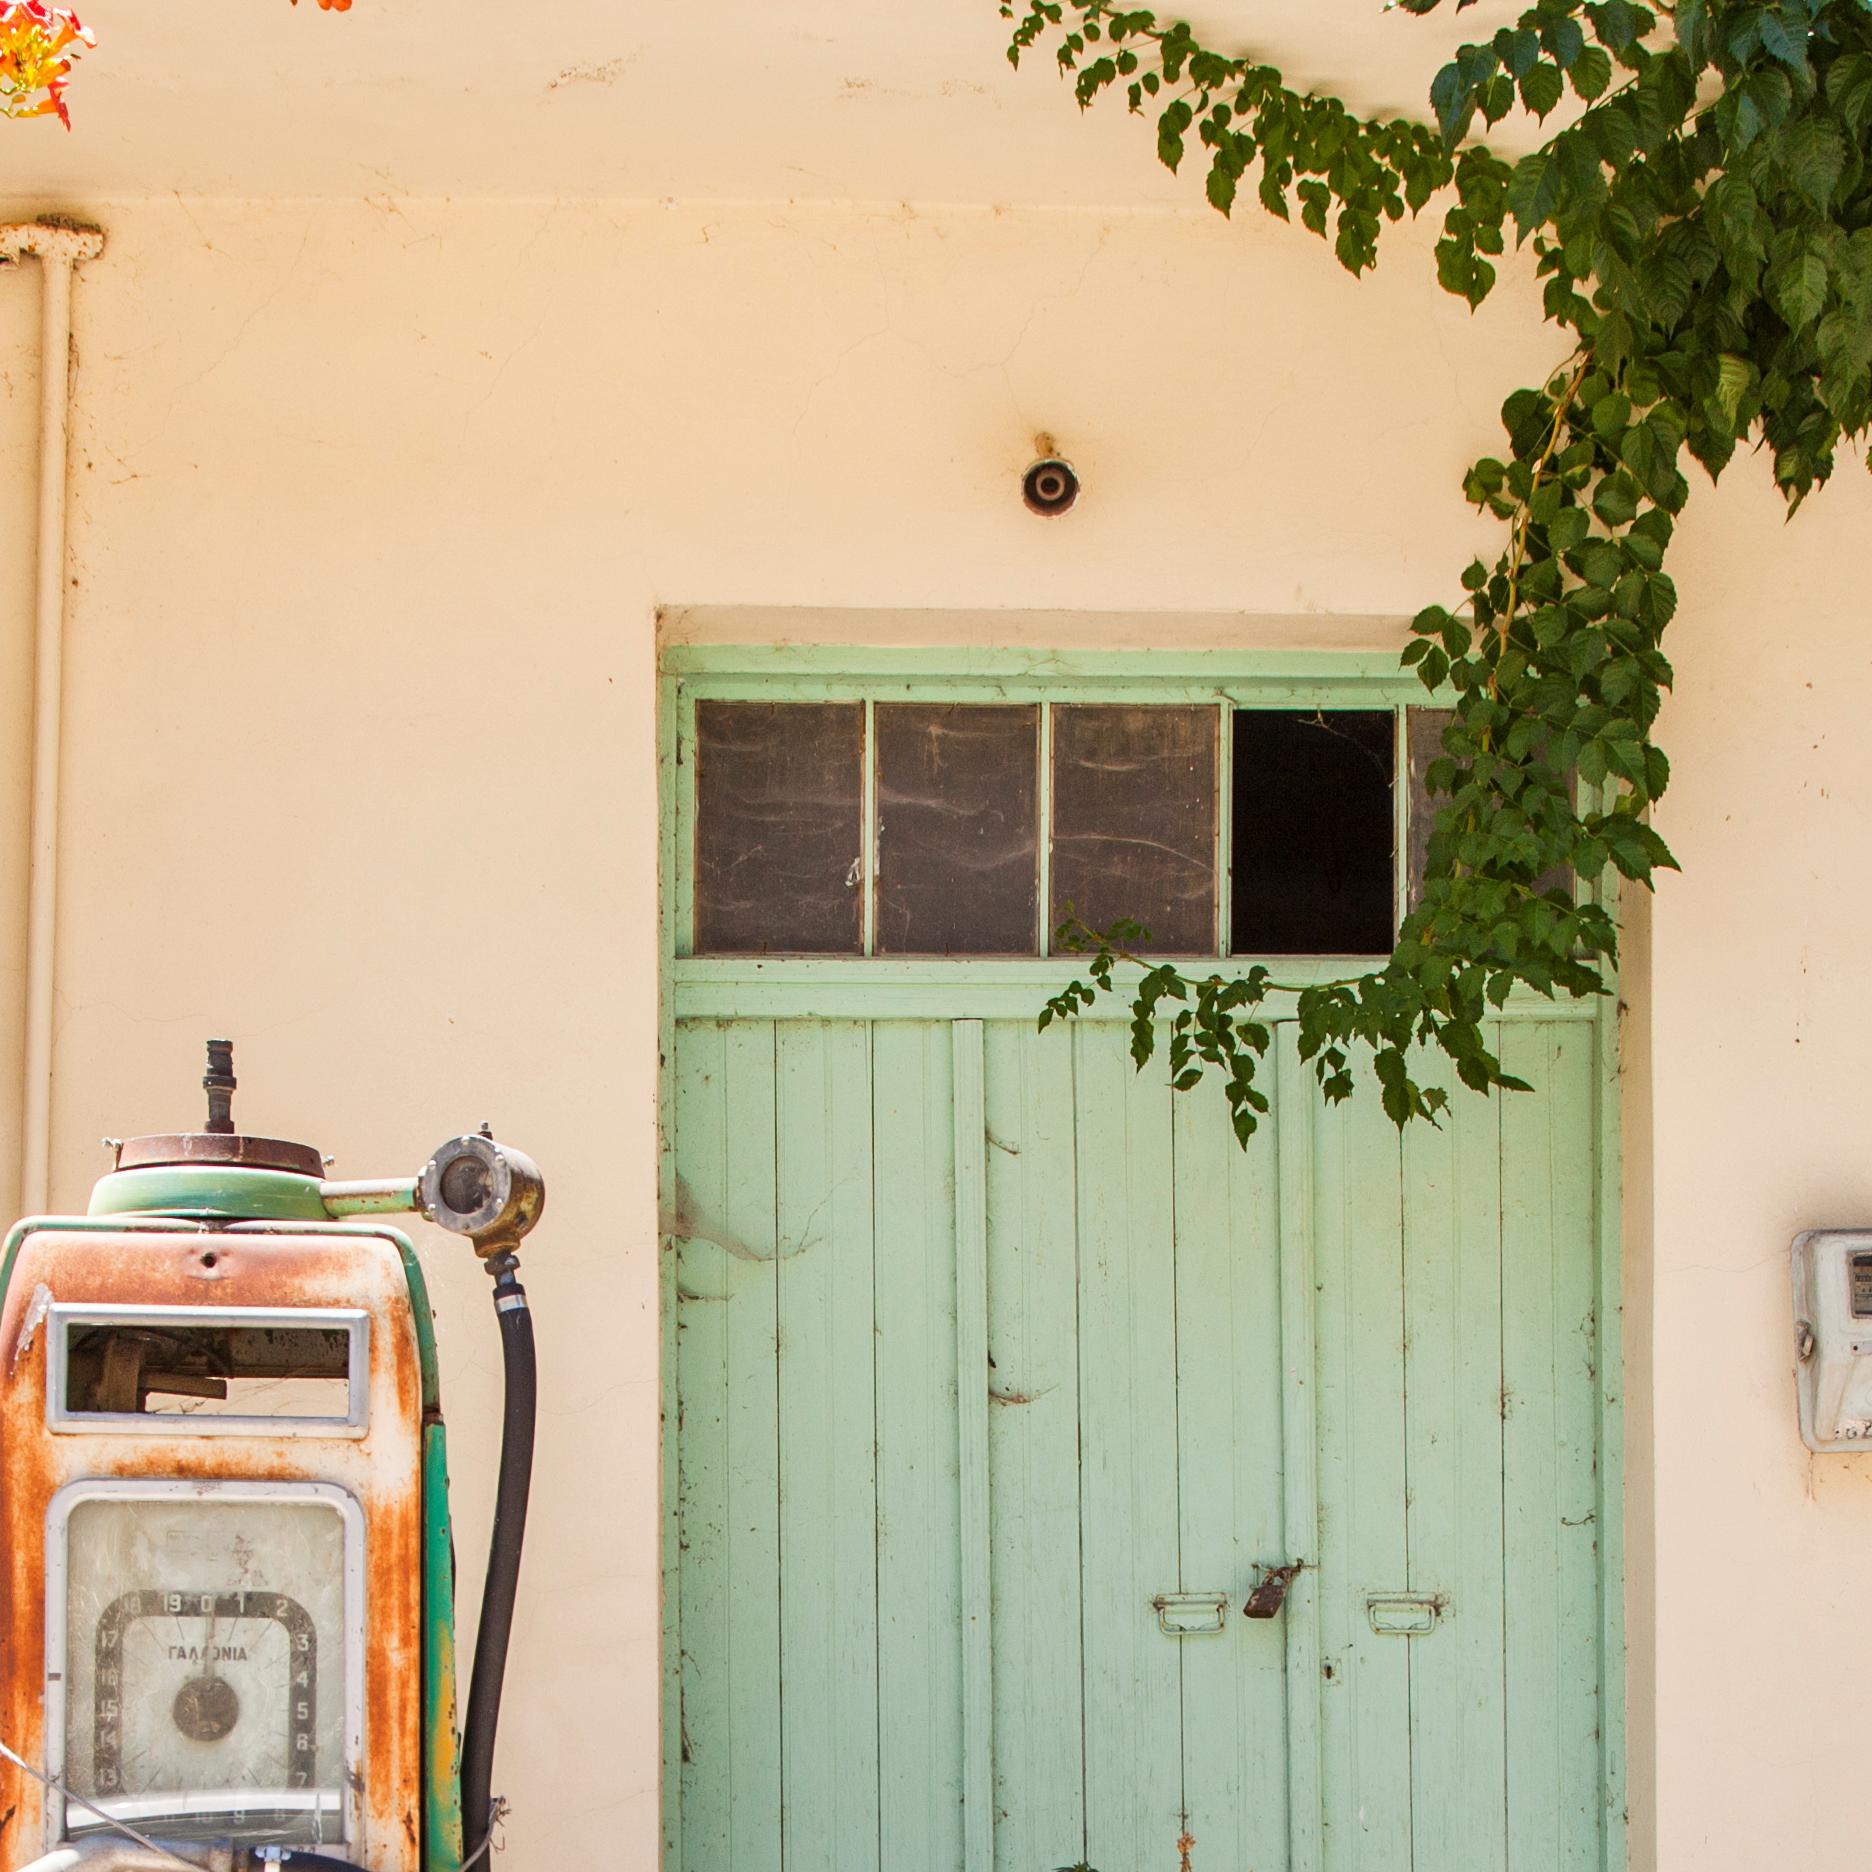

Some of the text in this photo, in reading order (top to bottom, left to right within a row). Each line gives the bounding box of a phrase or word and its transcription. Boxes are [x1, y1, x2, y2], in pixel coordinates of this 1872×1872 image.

[164, 1594, 182, 1613] 19
[201, 1595, 213, 1613] 0
[237, 1594, 245, 1614] 1
[276, 1598, 289, 1617] 2
[101, 1630, 119, 1648] 17
[297, 1633, 310, 1652] 3
[296, 1670, 309, 1688] 4
[100, 1699, 119, 1716] 15
[296, 1702, 309, 1720] 5
[296, 1733, 309, 1750] 6
[98, 1768, 117, 1787] 13
[296, 1772, 309, 1789] 7
